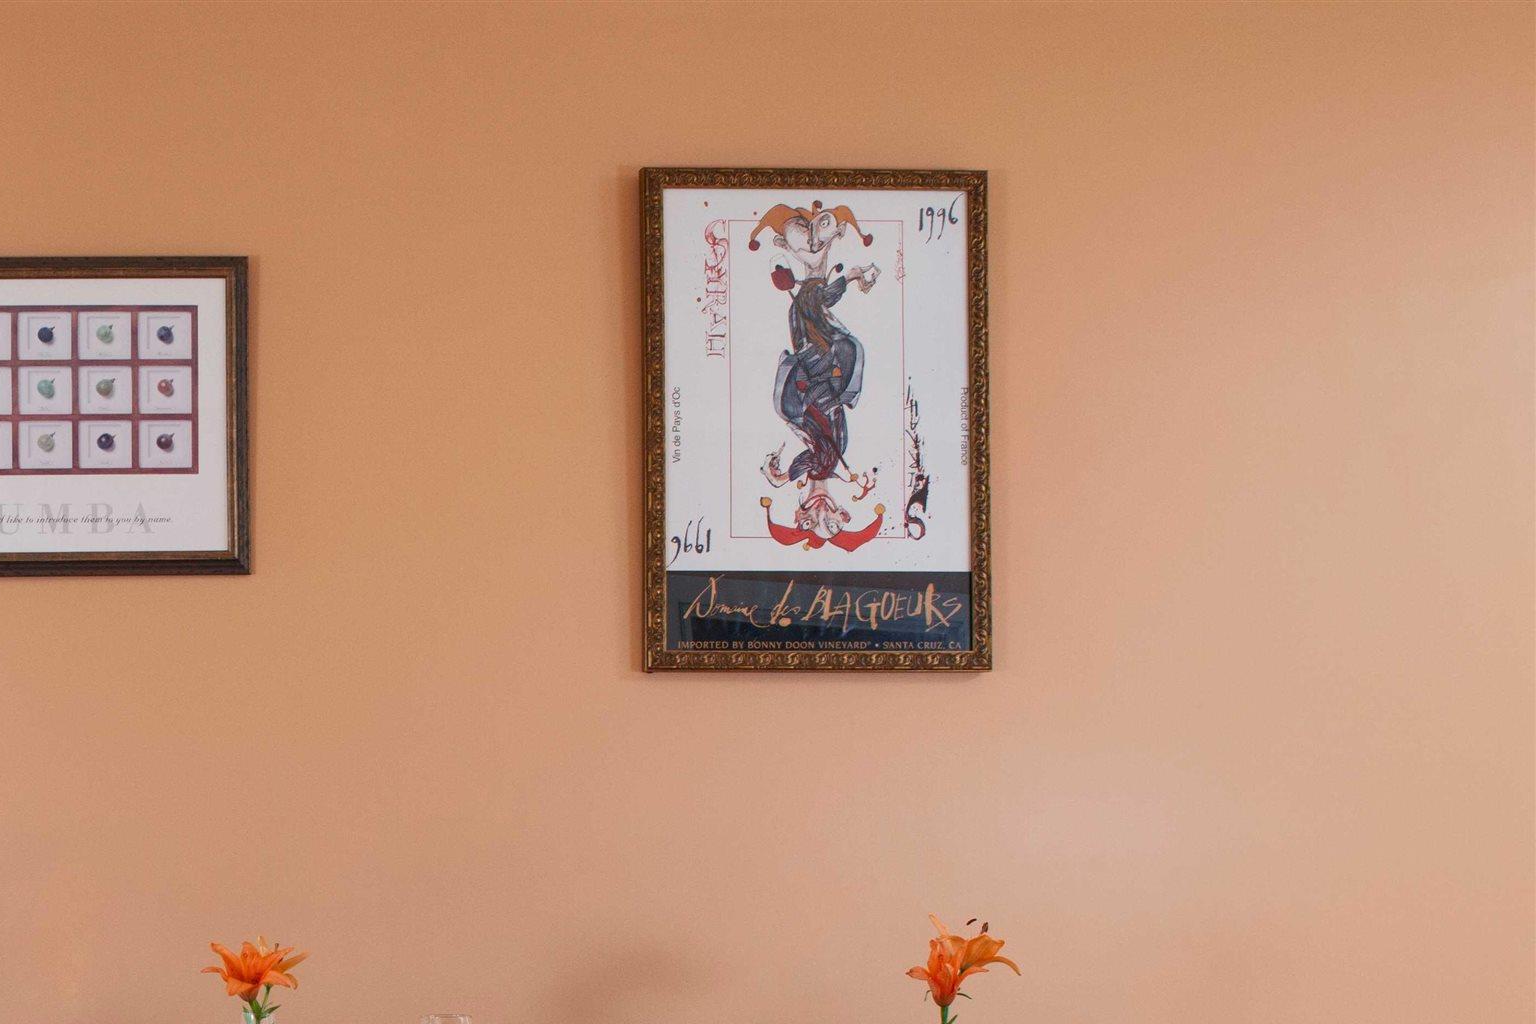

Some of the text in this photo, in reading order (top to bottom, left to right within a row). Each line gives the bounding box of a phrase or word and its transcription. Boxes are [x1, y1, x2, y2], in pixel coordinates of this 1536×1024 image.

[918, 193, 964, 244] 1996
[671, 386, 683, 463] Vin de Pays d'Oc
[960, 387, 969, 466] Product of France
[6, 514, 23, 524] like
[26, 516, 34, 524] to
[36, 514, 79, 525] introduce
[80, 514, 103, 524] them
[114, 517, 132, 527] you
[133, 515, 146, 527] by
[665, 516, 711, 568] 1996
[683, 574, 770, 628] Domaine
[770, 580, 801, 627] des
[677, 640, 730, 649] IMPORTED
[732, 640, 745, 649] BY
[747, 640, 782, 649] BONNY
[784, 640, 815, 649] DOON
[882, 640, 915, 650] SANTA
[948, 640, 962, 650] CA
